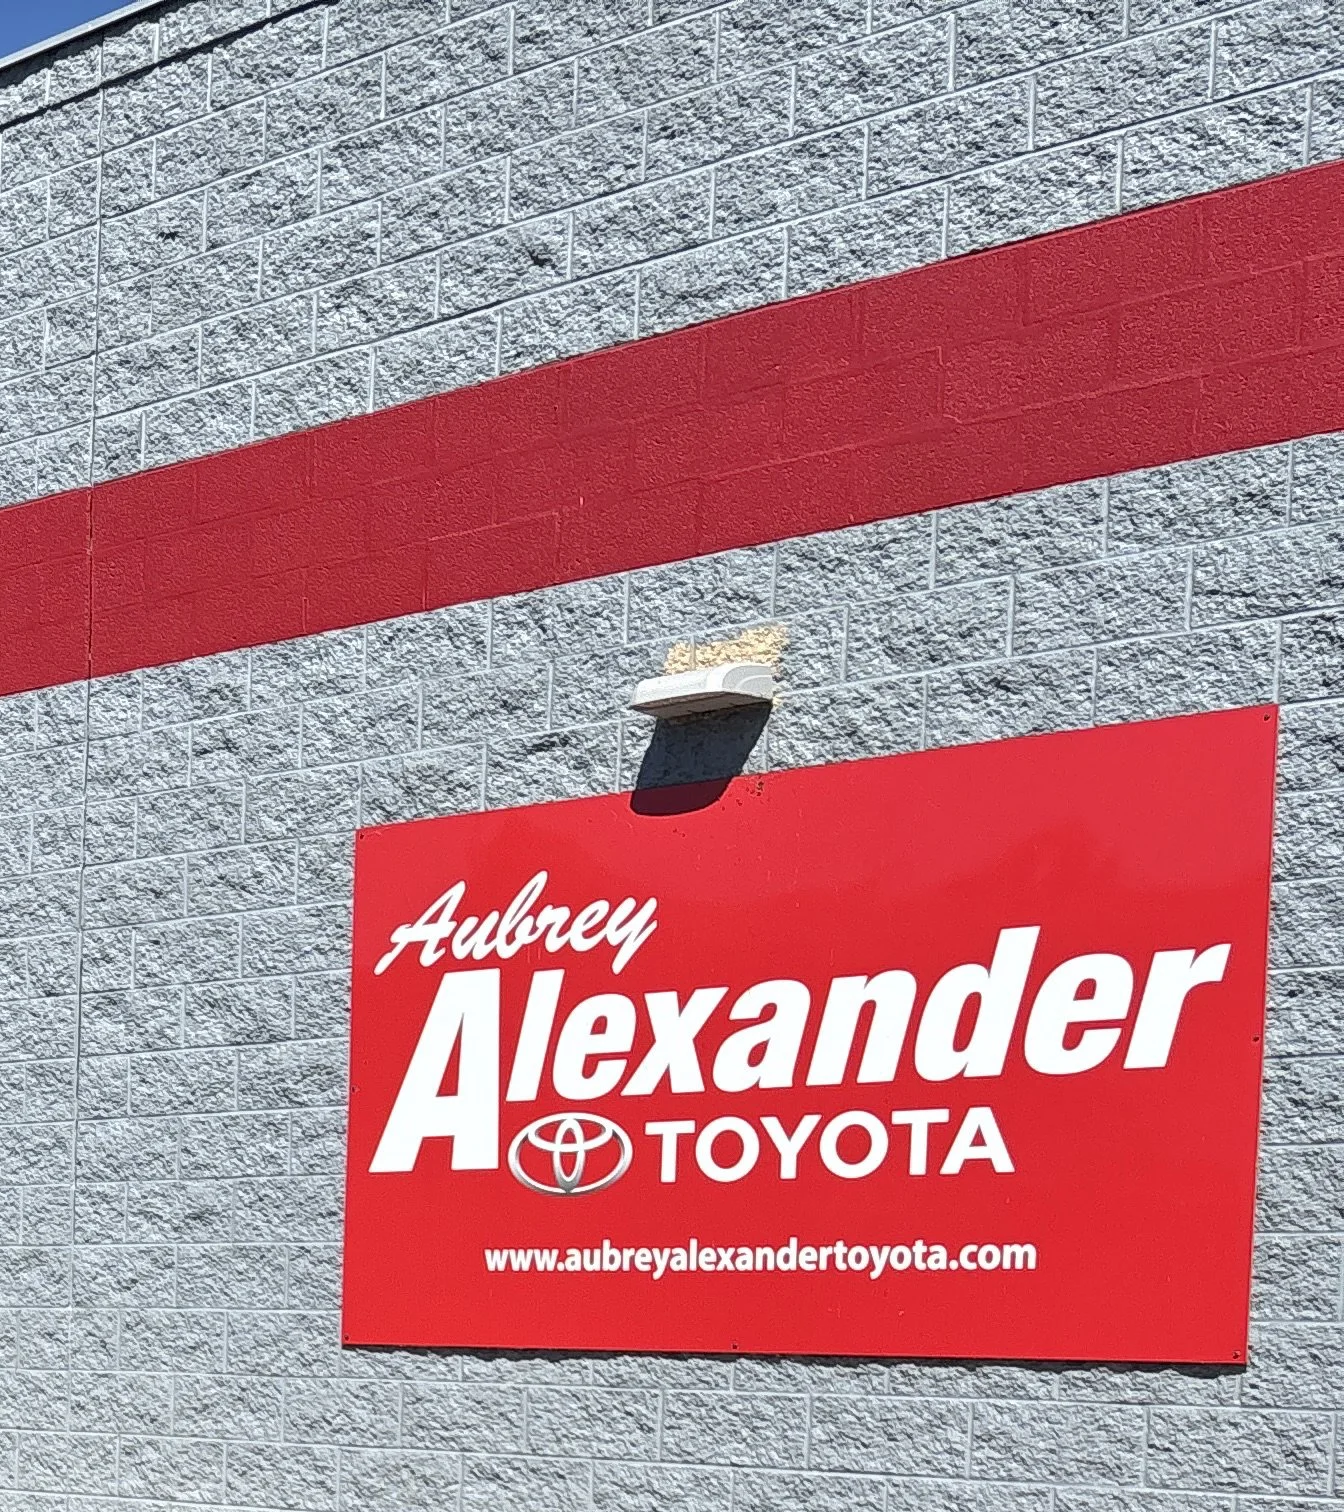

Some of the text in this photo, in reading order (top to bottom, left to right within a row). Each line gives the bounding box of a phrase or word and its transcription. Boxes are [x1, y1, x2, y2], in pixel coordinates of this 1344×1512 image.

[373, 870, 658, 976] Aubrey
[368, 925, 1232, 1173] Alexander
[644, 1106, 1015, 1183] TOYOTA
[484, 1236, 1037, 1281] www.aubreyalexandertoyota.com
